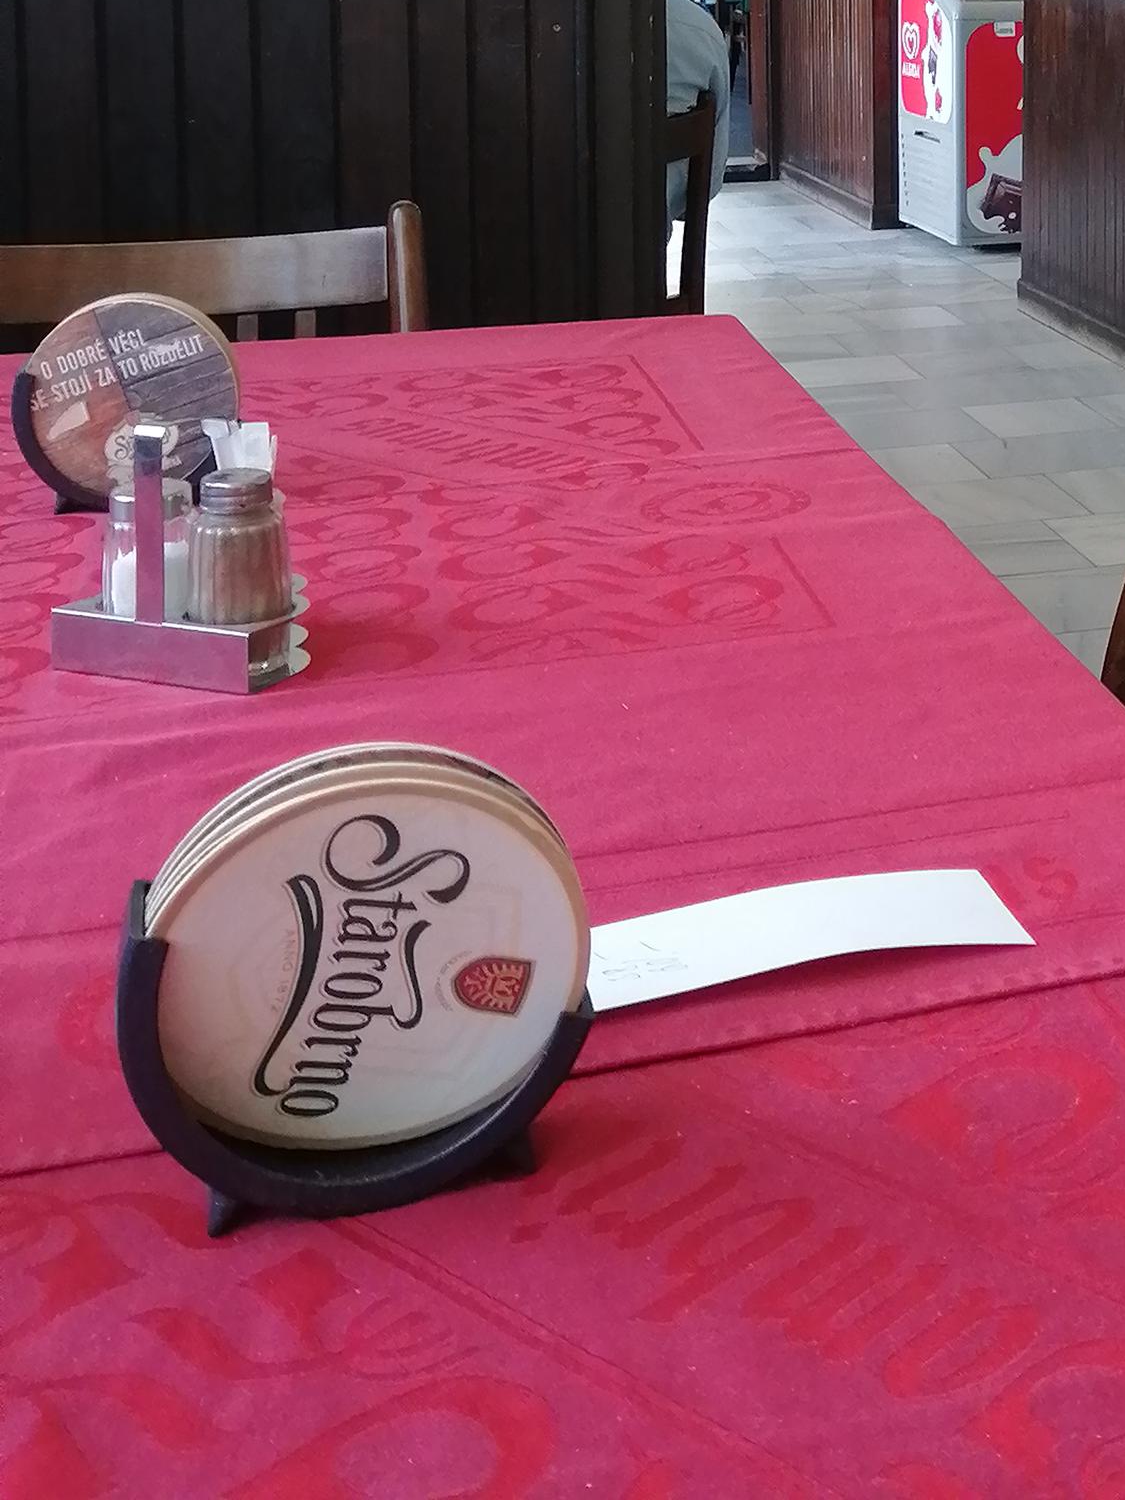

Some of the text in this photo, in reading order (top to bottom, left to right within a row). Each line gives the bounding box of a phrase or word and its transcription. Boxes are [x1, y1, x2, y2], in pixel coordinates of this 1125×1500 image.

[40, 360, 53, 381] O
[56, 340, 108, 375] DOBRÉ
[51, 369, 93, 402] STOJÍ
[94, 366, 118, 388] ZA
[117, 357, 139, 380] TO
[276, 814, 471, 1118] Starobrno
